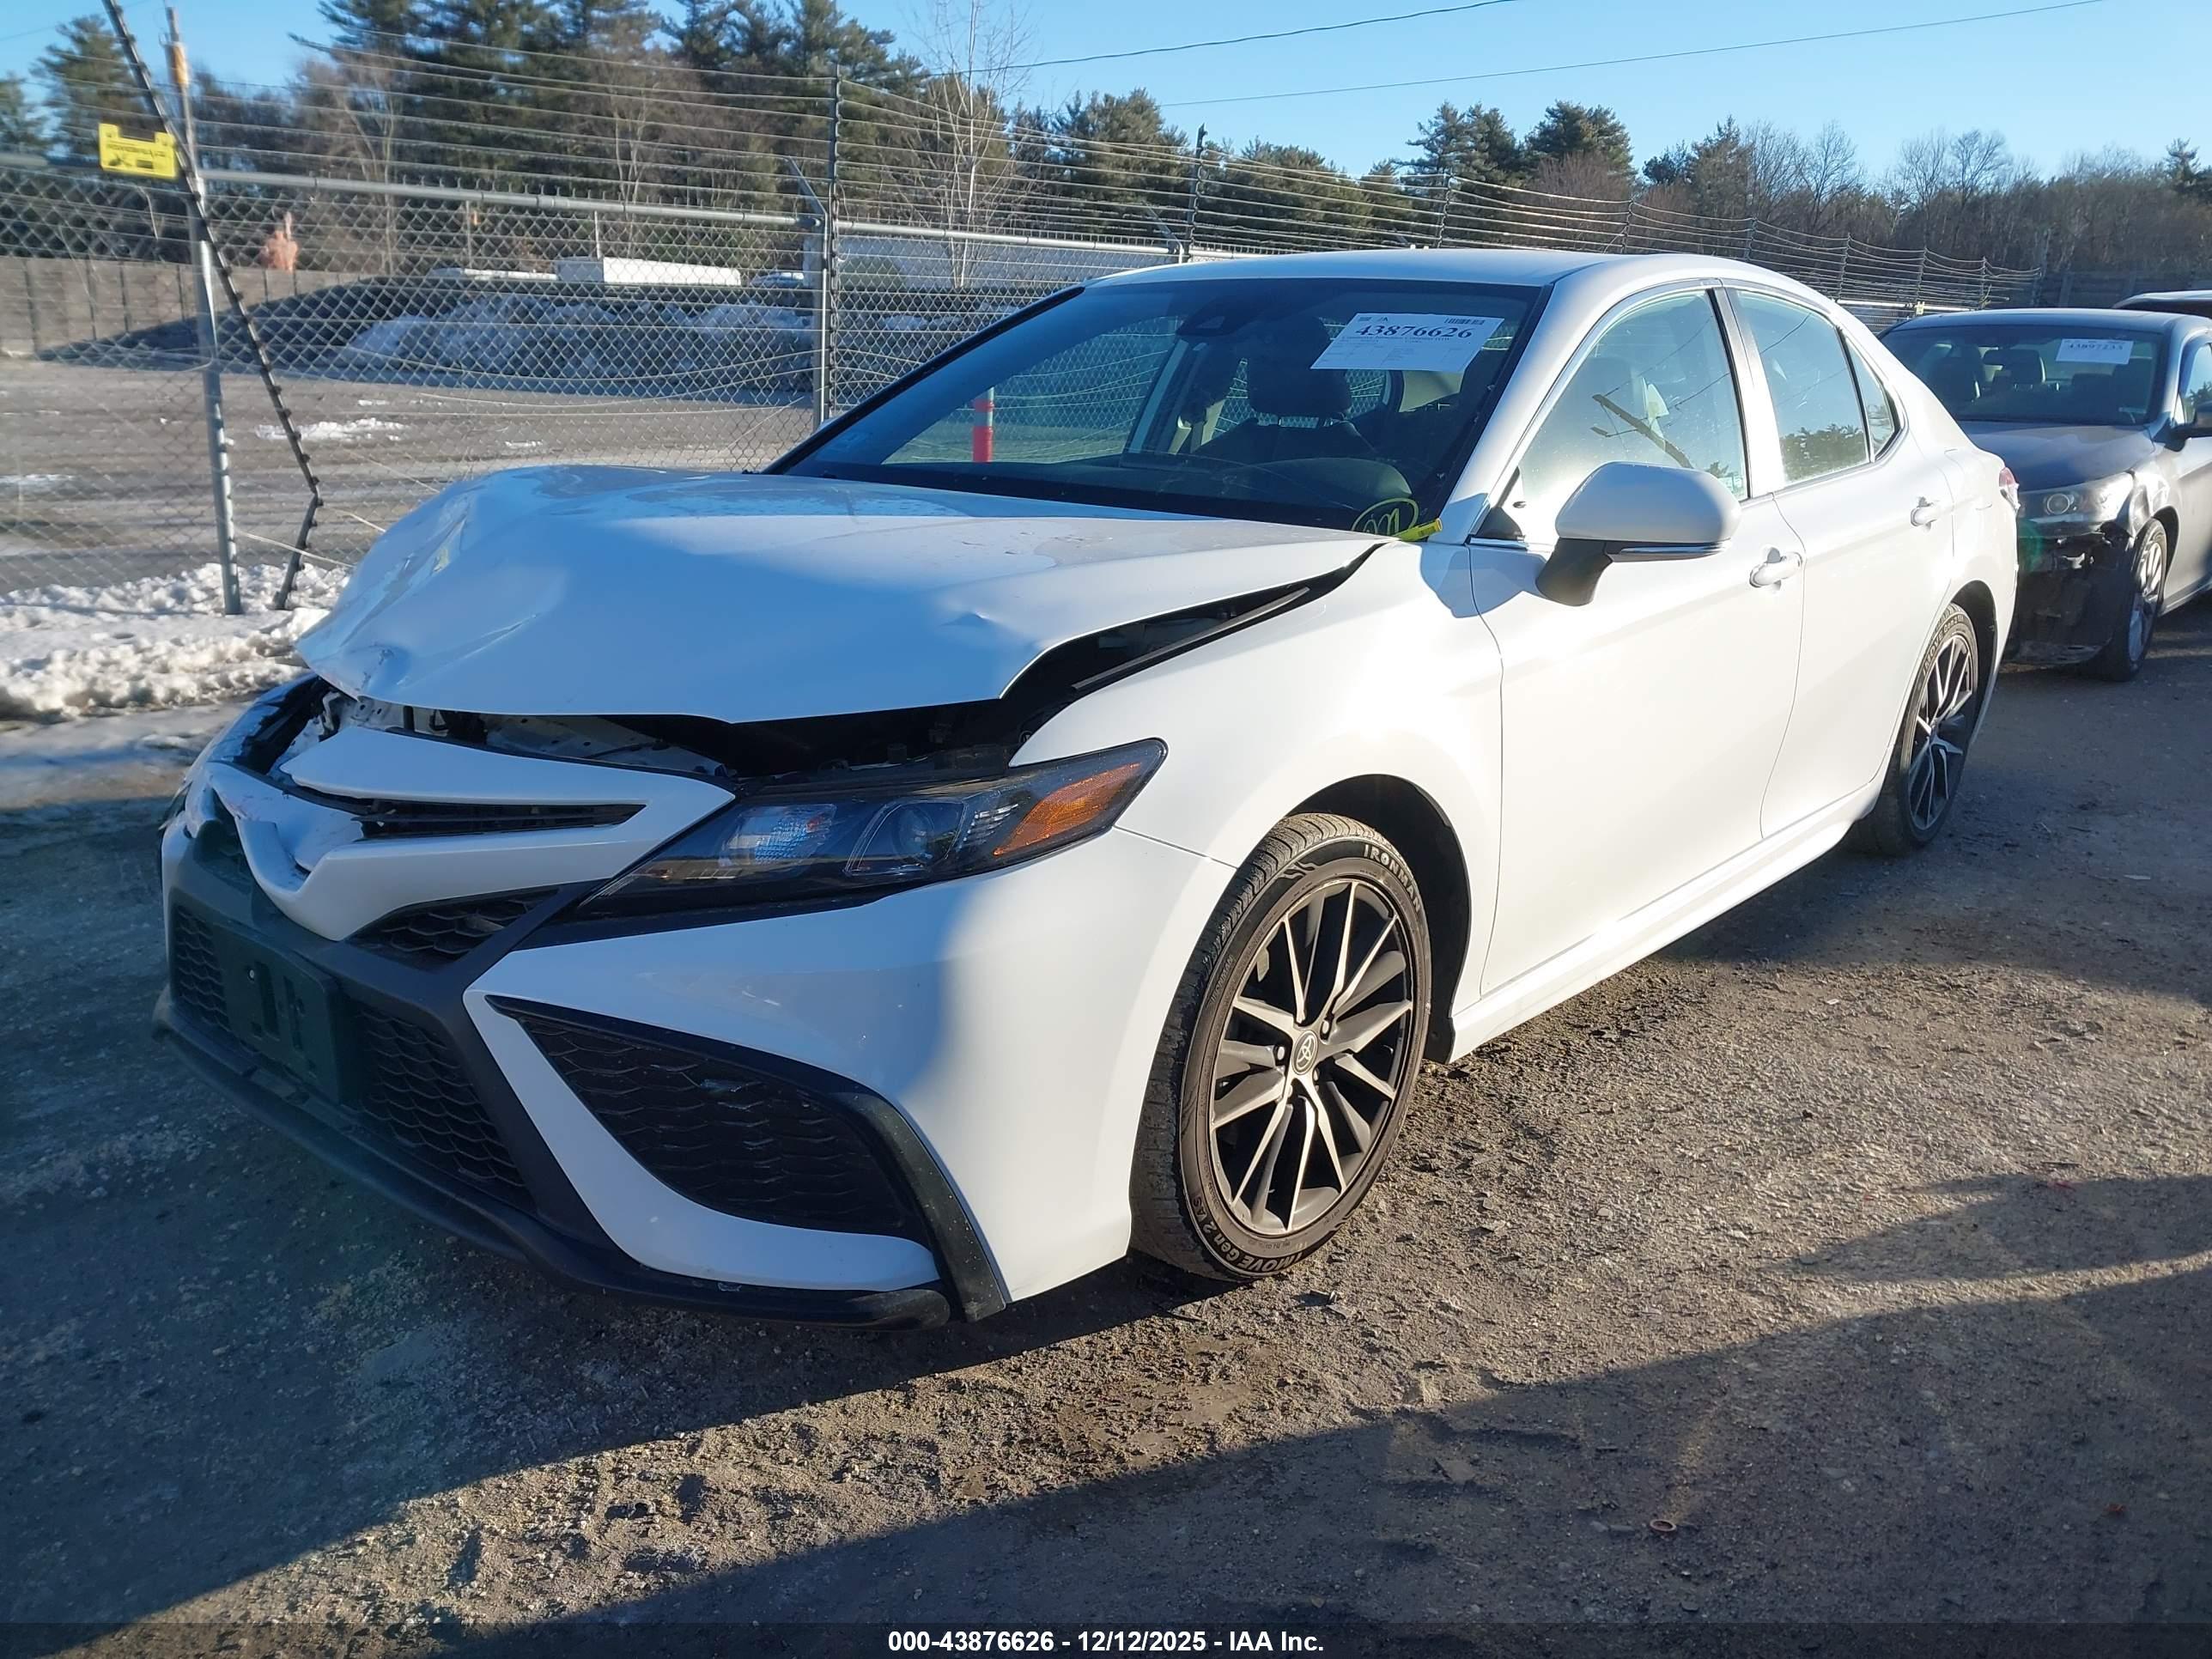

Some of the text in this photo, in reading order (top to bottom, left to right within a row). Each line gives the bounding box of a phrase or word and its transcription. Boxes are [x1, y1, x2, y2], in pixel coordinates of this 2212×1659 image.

[1356, 325, 1475, 339] 43876626
[1364, 843, 1421, 912] IRONMAN
[1193, 1195, 1208, 1222] AS
[1203, 1220, 1218, 1234] 2
[1213, 1233, 1240, 1262] Gen
